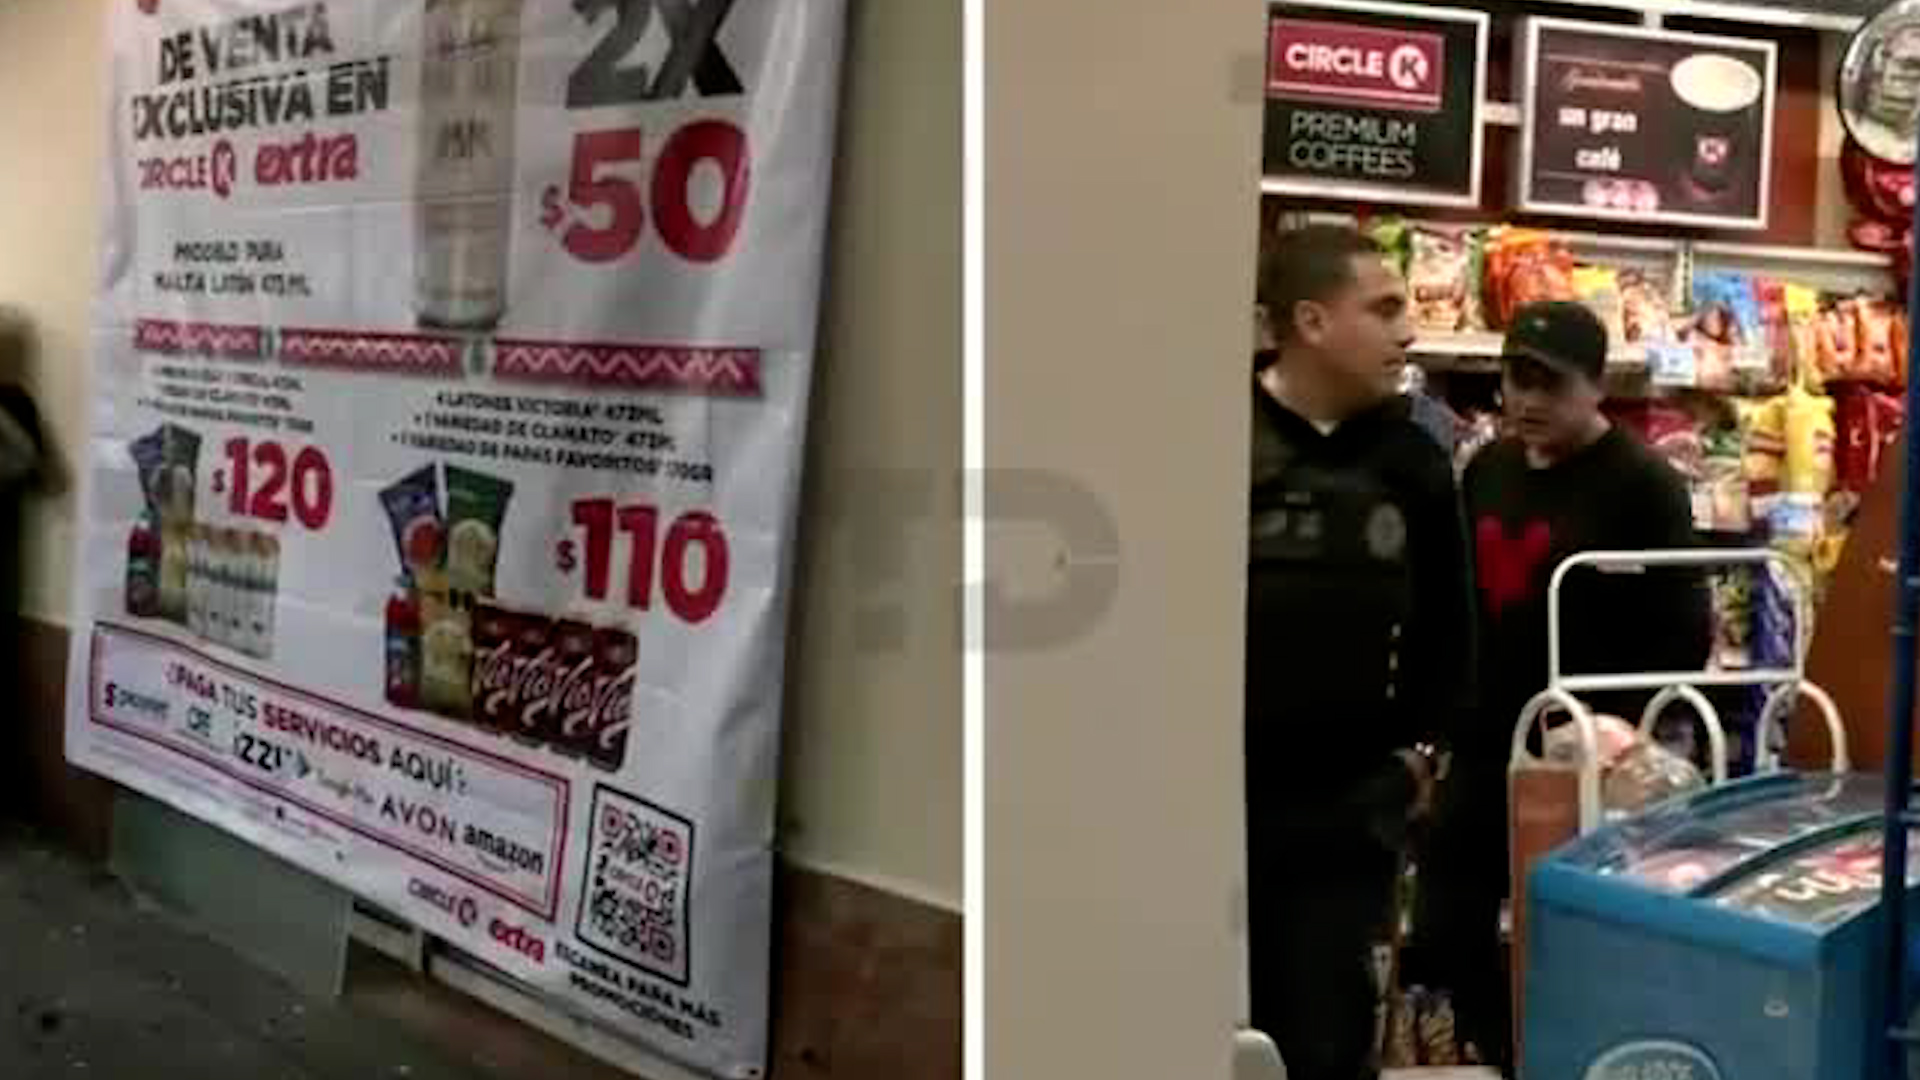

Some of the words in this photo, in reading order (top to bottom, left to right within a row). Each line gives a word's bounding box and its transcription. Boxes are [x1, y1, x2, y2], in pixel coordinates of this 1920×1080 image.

[160, 31, 194, 84] DE
[200, 2, 335, 72] VENTA
[1285, 42, 1384, 78] CIRCLE
[1389, 44, 1428, 89] K
[327, 56, 391, 116] EN
[1590, 109, 1638, 134] gran
[254, 132, 358, 185] extra
[1288, 141, 1416, 178] COFFEES
[1289, 110, 1418, 147] PREMIUM
[539, 116, 750, 265] $50
[211, 436, 333, 532] $120
[556, 496, 731, 625] $110
[222, 684, 258, 720] TUS
[262, 701, 383, 767] SERVICIOS
[380, 793, 457, 843] AVON
[463, 824, 545, 876] amazon
